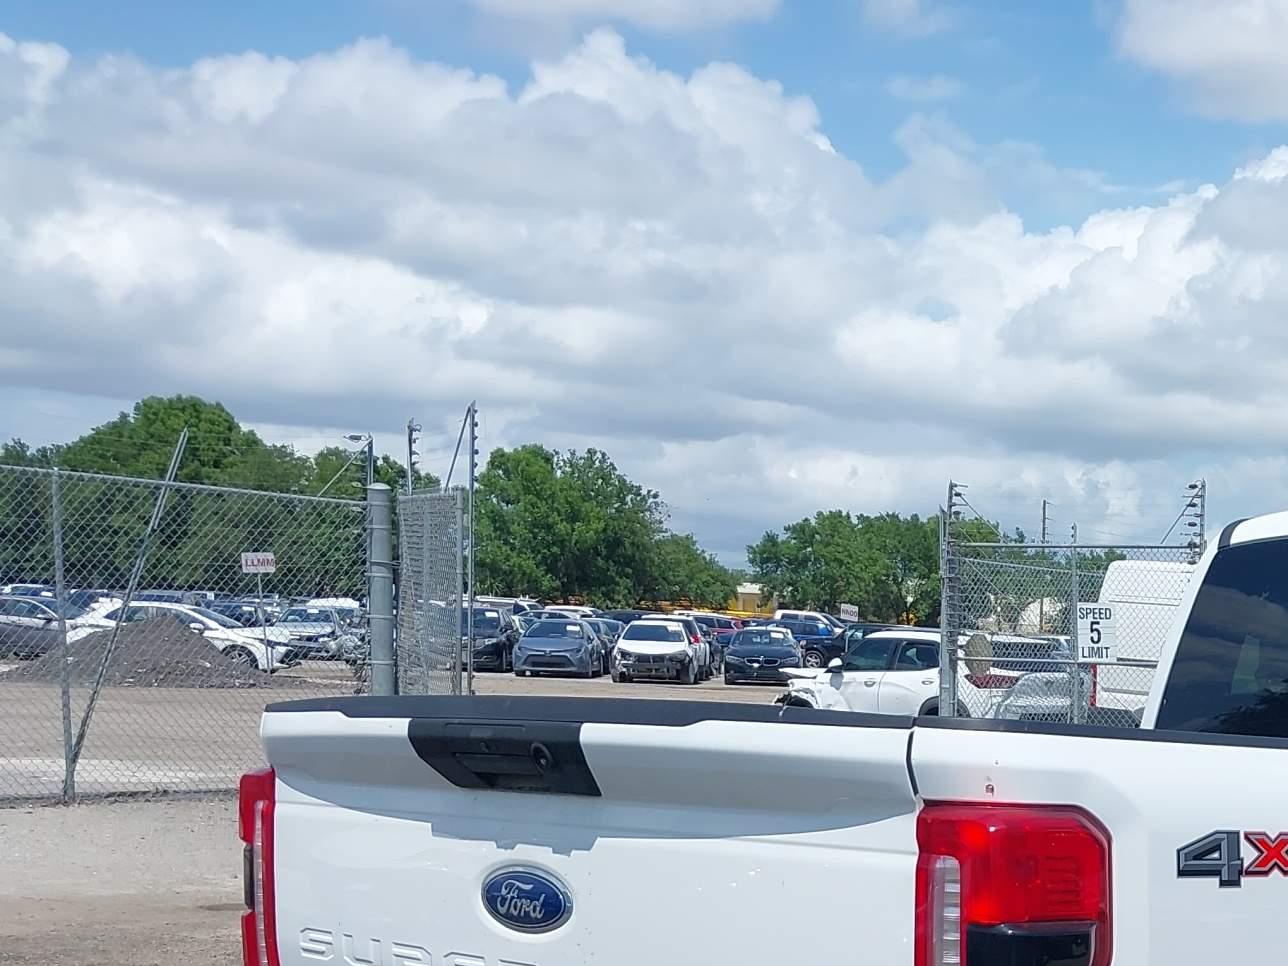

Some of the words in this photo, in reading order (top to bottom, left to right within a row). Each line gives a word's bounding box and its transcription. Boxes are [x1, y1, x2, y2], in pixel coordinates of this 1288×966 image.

[1078, 606, 1112, 620] SPEED
[1090, 620, 1102, 645] 5
[1081, 646, 1111, 659] LIMIT
[496, 879, 546, 919] Ford
